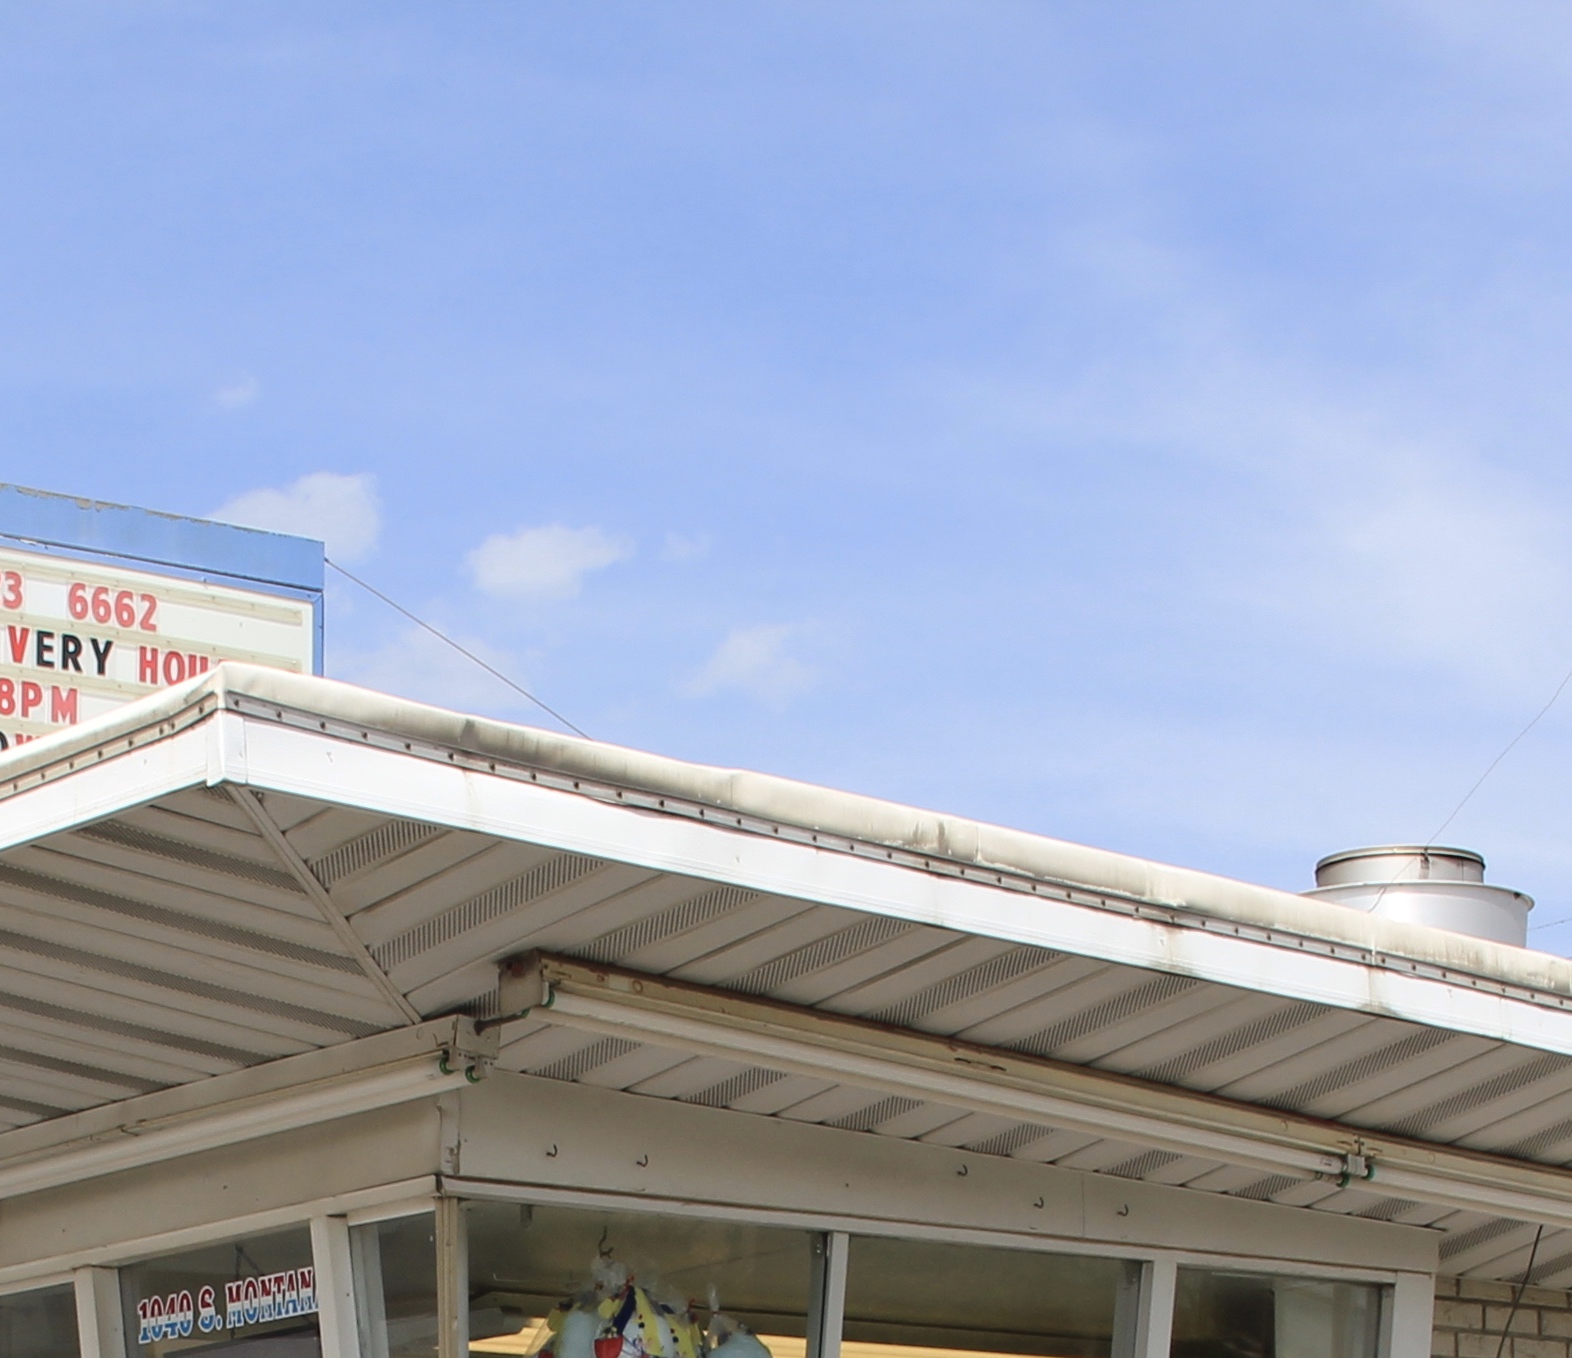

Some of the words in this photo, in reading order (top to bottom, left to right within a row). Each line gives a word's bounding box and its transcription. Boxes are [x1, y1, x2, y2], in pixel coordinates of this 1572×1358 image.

[69, 582, 158, 631] 6662
[137, 1290, 194, 1345] 1040
[199, 1285, 223, 1333] S.
[225, 1266, 319, 1329] MONTAN
